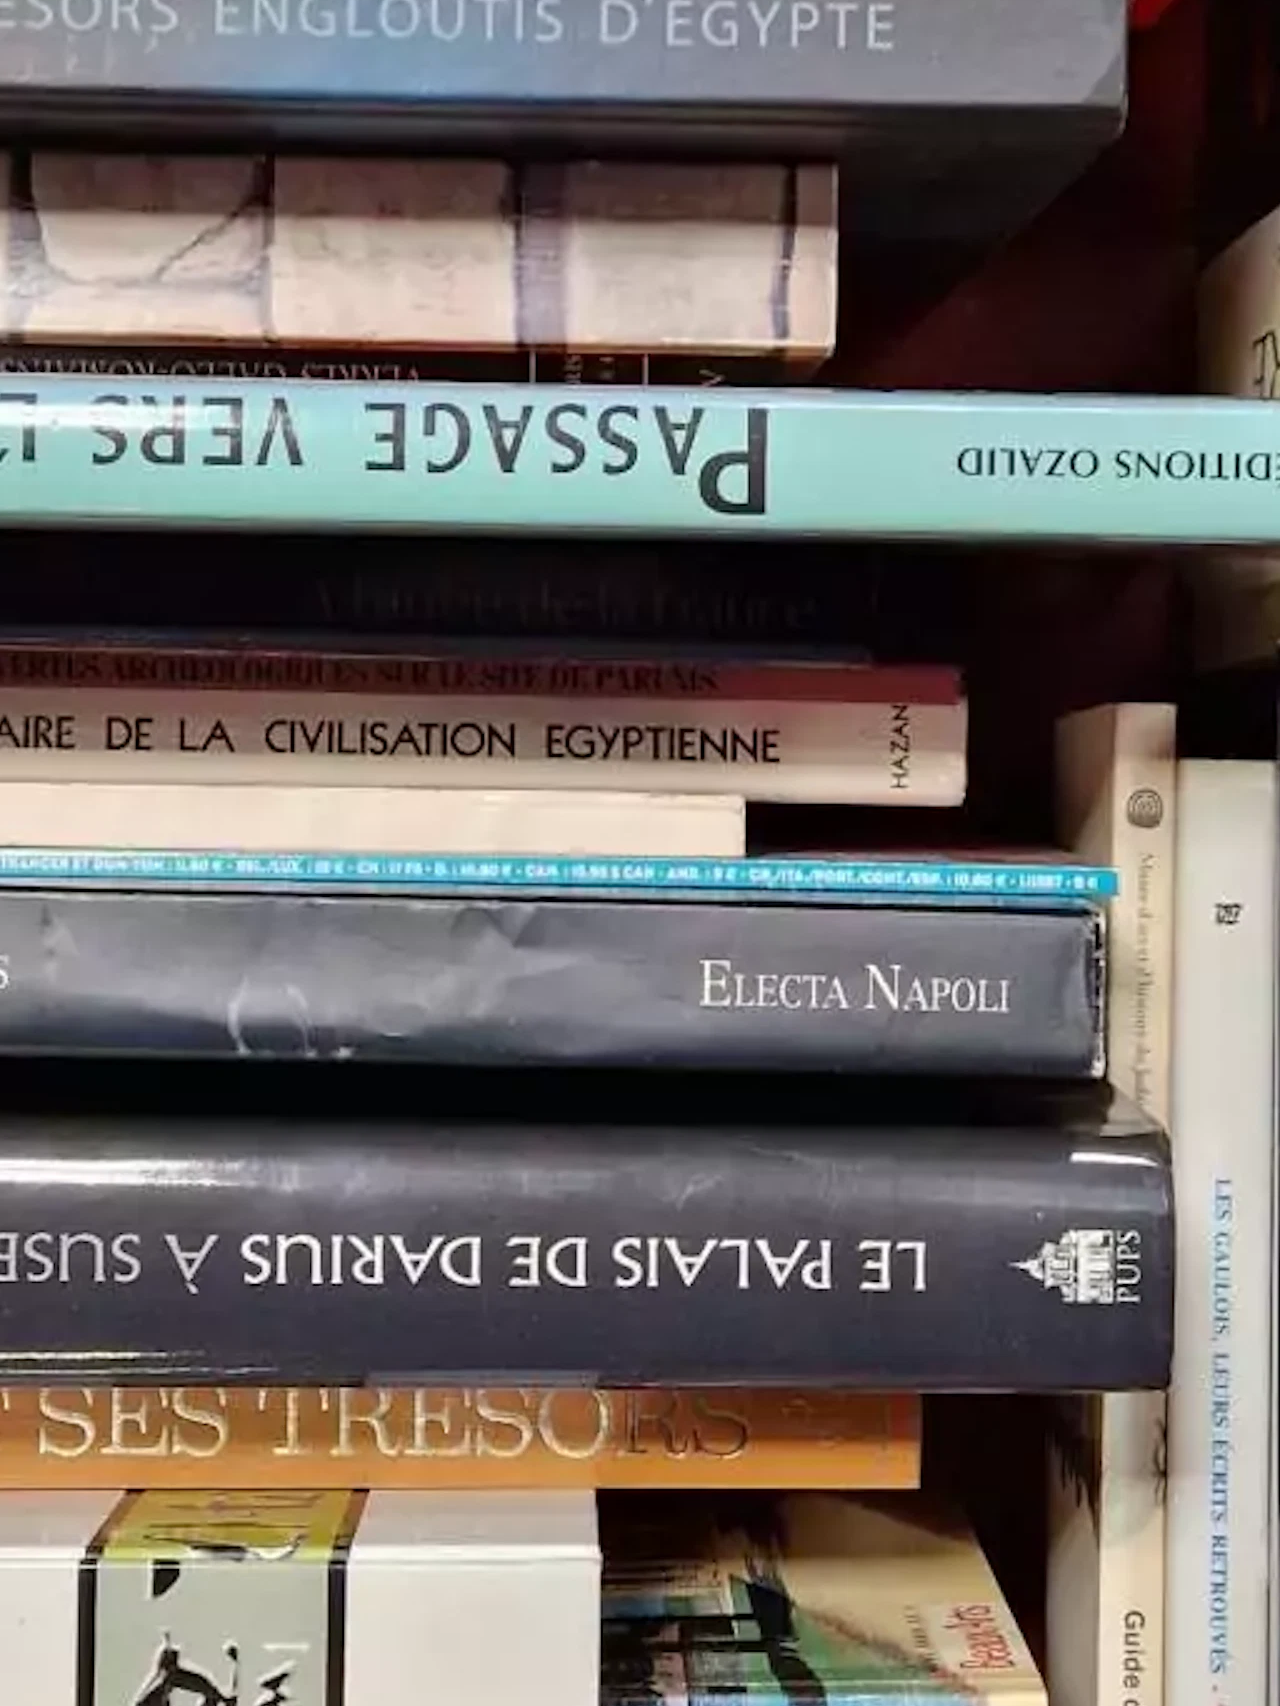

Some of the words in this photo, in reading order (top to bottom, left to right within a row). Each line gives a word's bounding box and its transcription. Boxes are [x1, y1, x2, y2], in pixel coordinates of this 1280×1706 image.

[91, 394, 305, 467] VERS
[365, 401, 770, 516] PASSAGE
[956, 446, 1100, 481] OZALID
[104, 717, 153, 750] DE
[178, 718, 236, 753] LA
[264, 718, 517, 759] CIVILISATION
[544, 723, 781, 765] EGYPTIENNE
[888, 704, 912, 789] HAZAN
[1211, 1177, 1234, 1221] LES
[163, 1232, 221, 1295] À
[239, 1232, 484, 1288] DARIUS
[504, 1233, 589, 1289] DE
[611, 1235, 834, 1290] PALAIS
[858, 1236, 928, 1293] LE
[1116, 1229, 1142, 1304] PUPS
[1208, 1231, 1234, 1343] GAULOIS,
[36, 1387, 230, 1459] SES
[1210, 1351, 1233, 1430] LEURS
[1122, 1609, 1149, 1690] Guide
